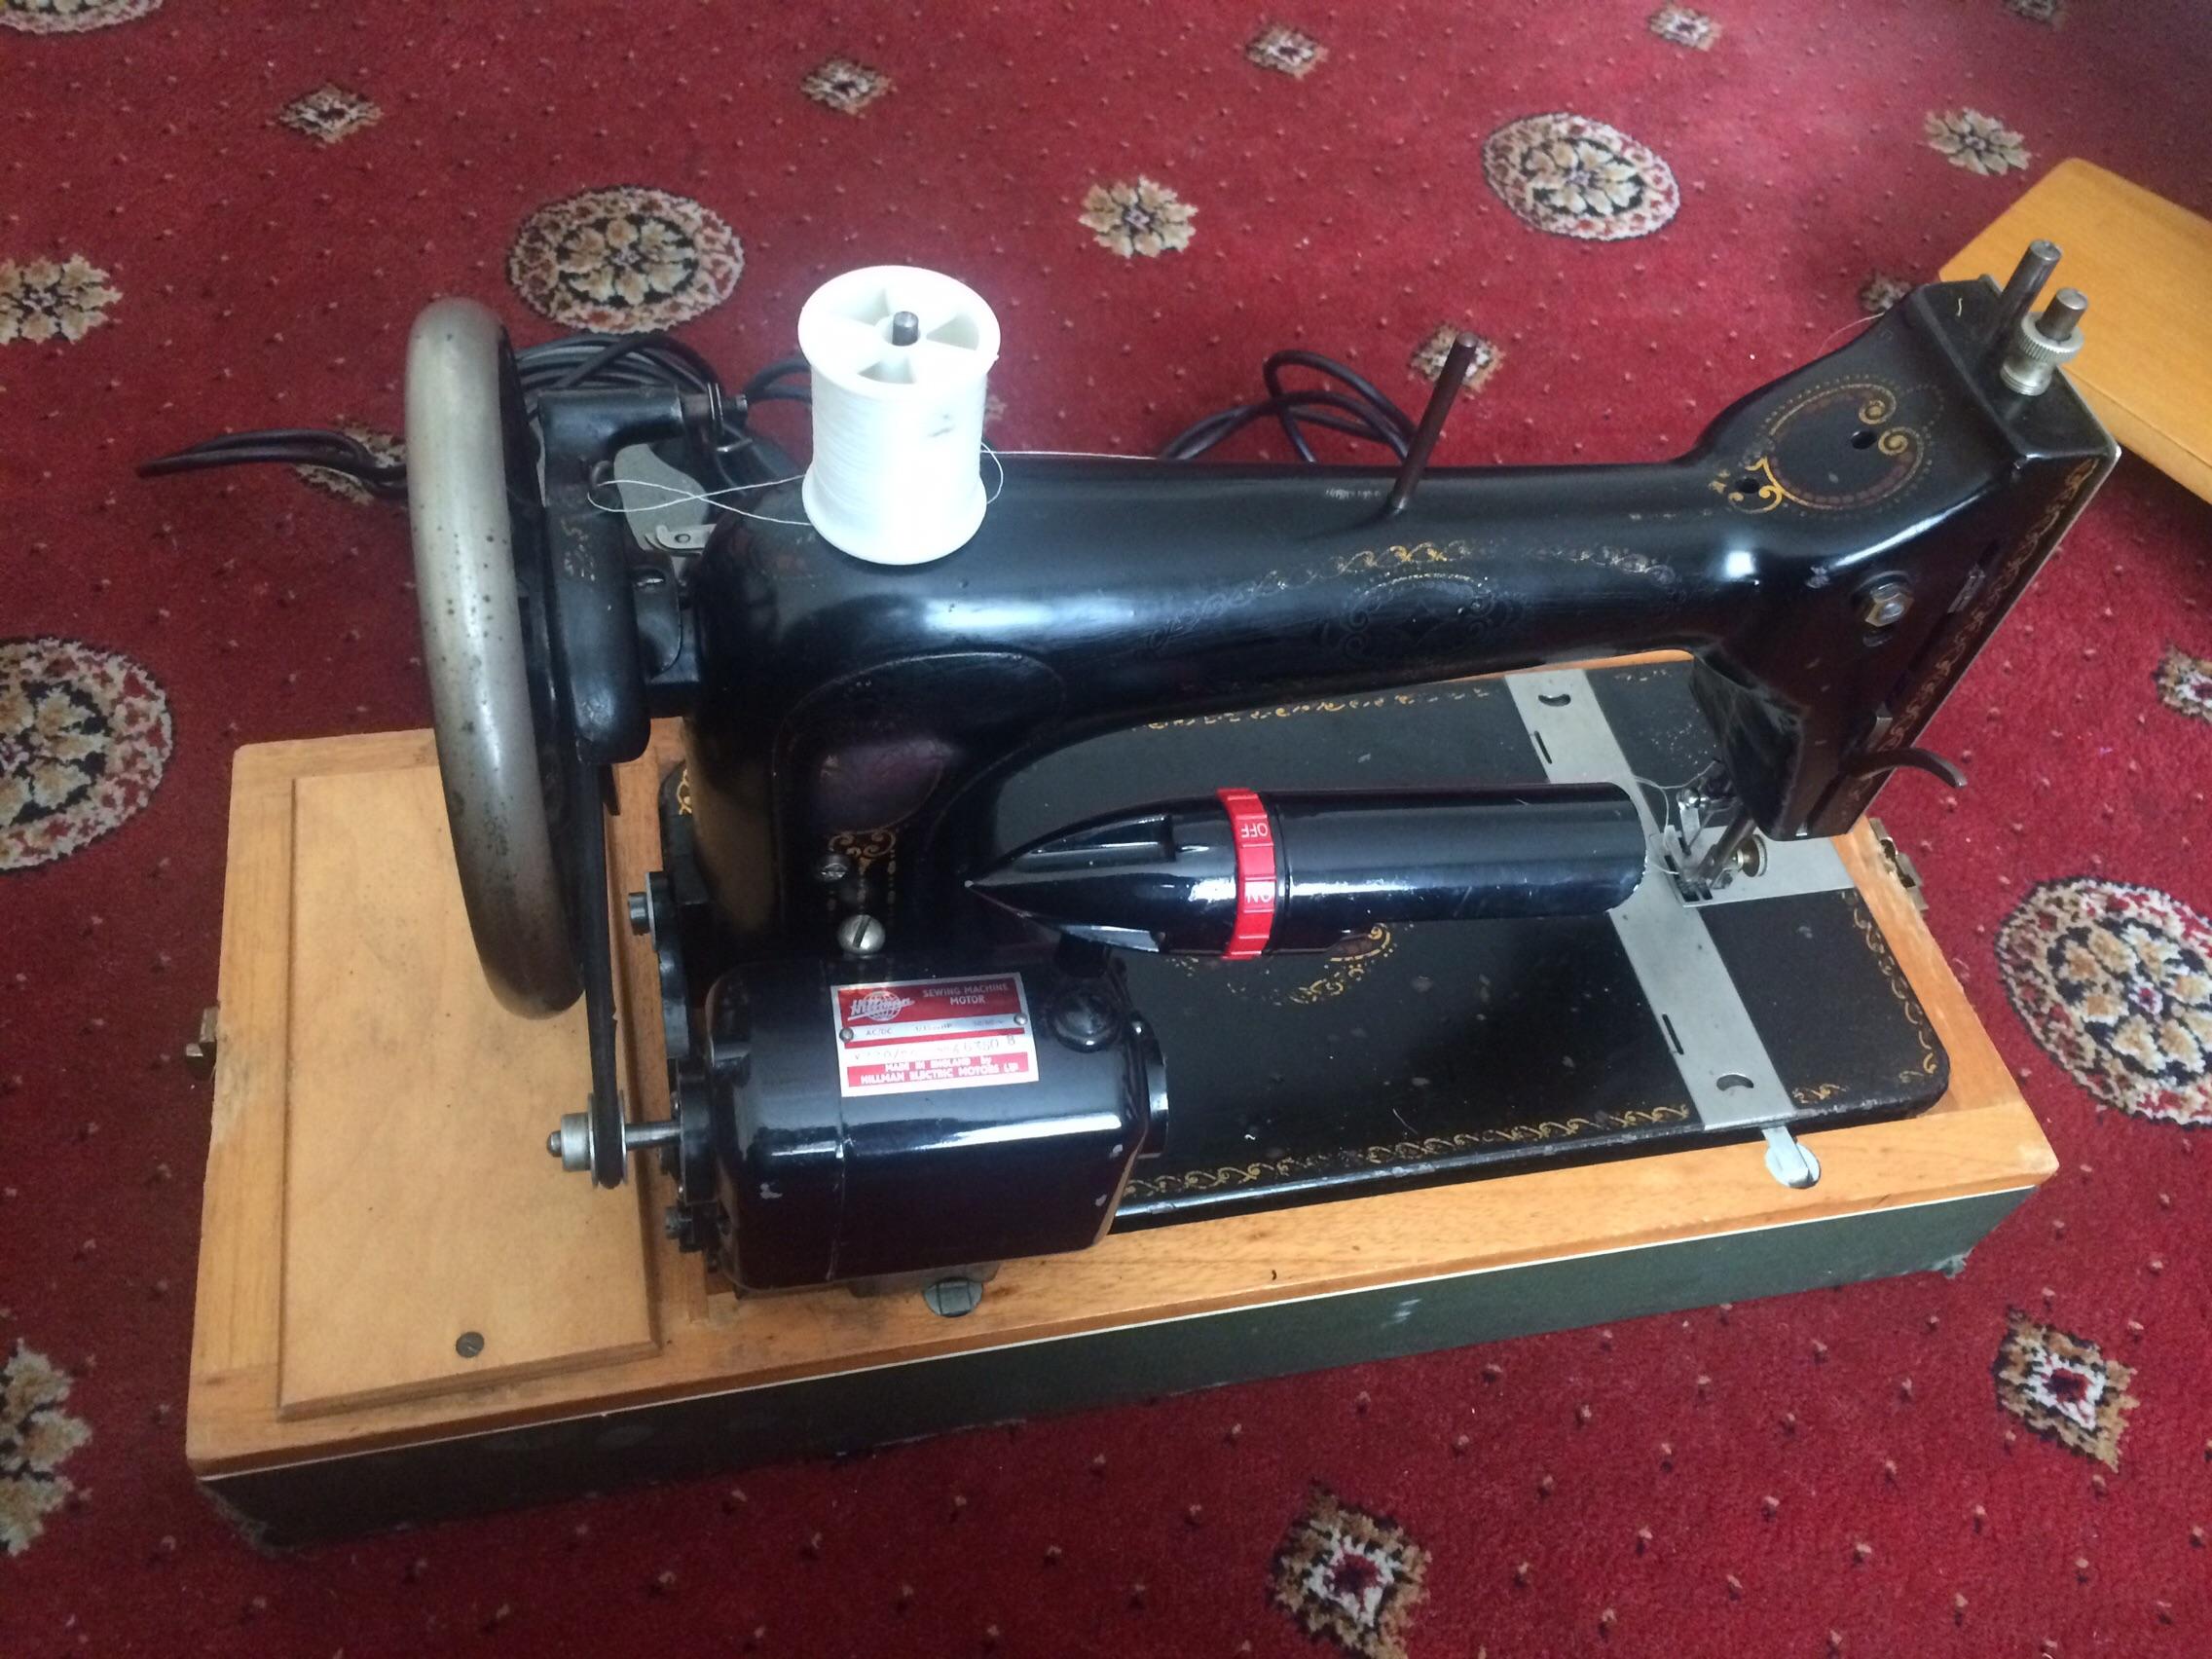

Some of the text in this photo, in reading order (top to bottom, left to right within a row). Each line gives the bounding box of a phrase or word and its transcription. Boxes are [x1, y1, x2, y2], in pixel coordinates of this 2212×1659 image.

[1240, 823, 1268, 838] OFF
[1245, 887, 1272, 903] ON
[923, 983, 1010, 998] SEWING MACHINE
[950, 995, 986, 1006] MOTOR
[915, 1060, 926, 1070] IN
[930, 1057, 972, 1068] ENGLAND
[861, 1072, 905, 1085] HILLMAN
[909, 1067, 954, 1081] ELECTRIC
[958, 1063, 1000, 1076] MOTORS
